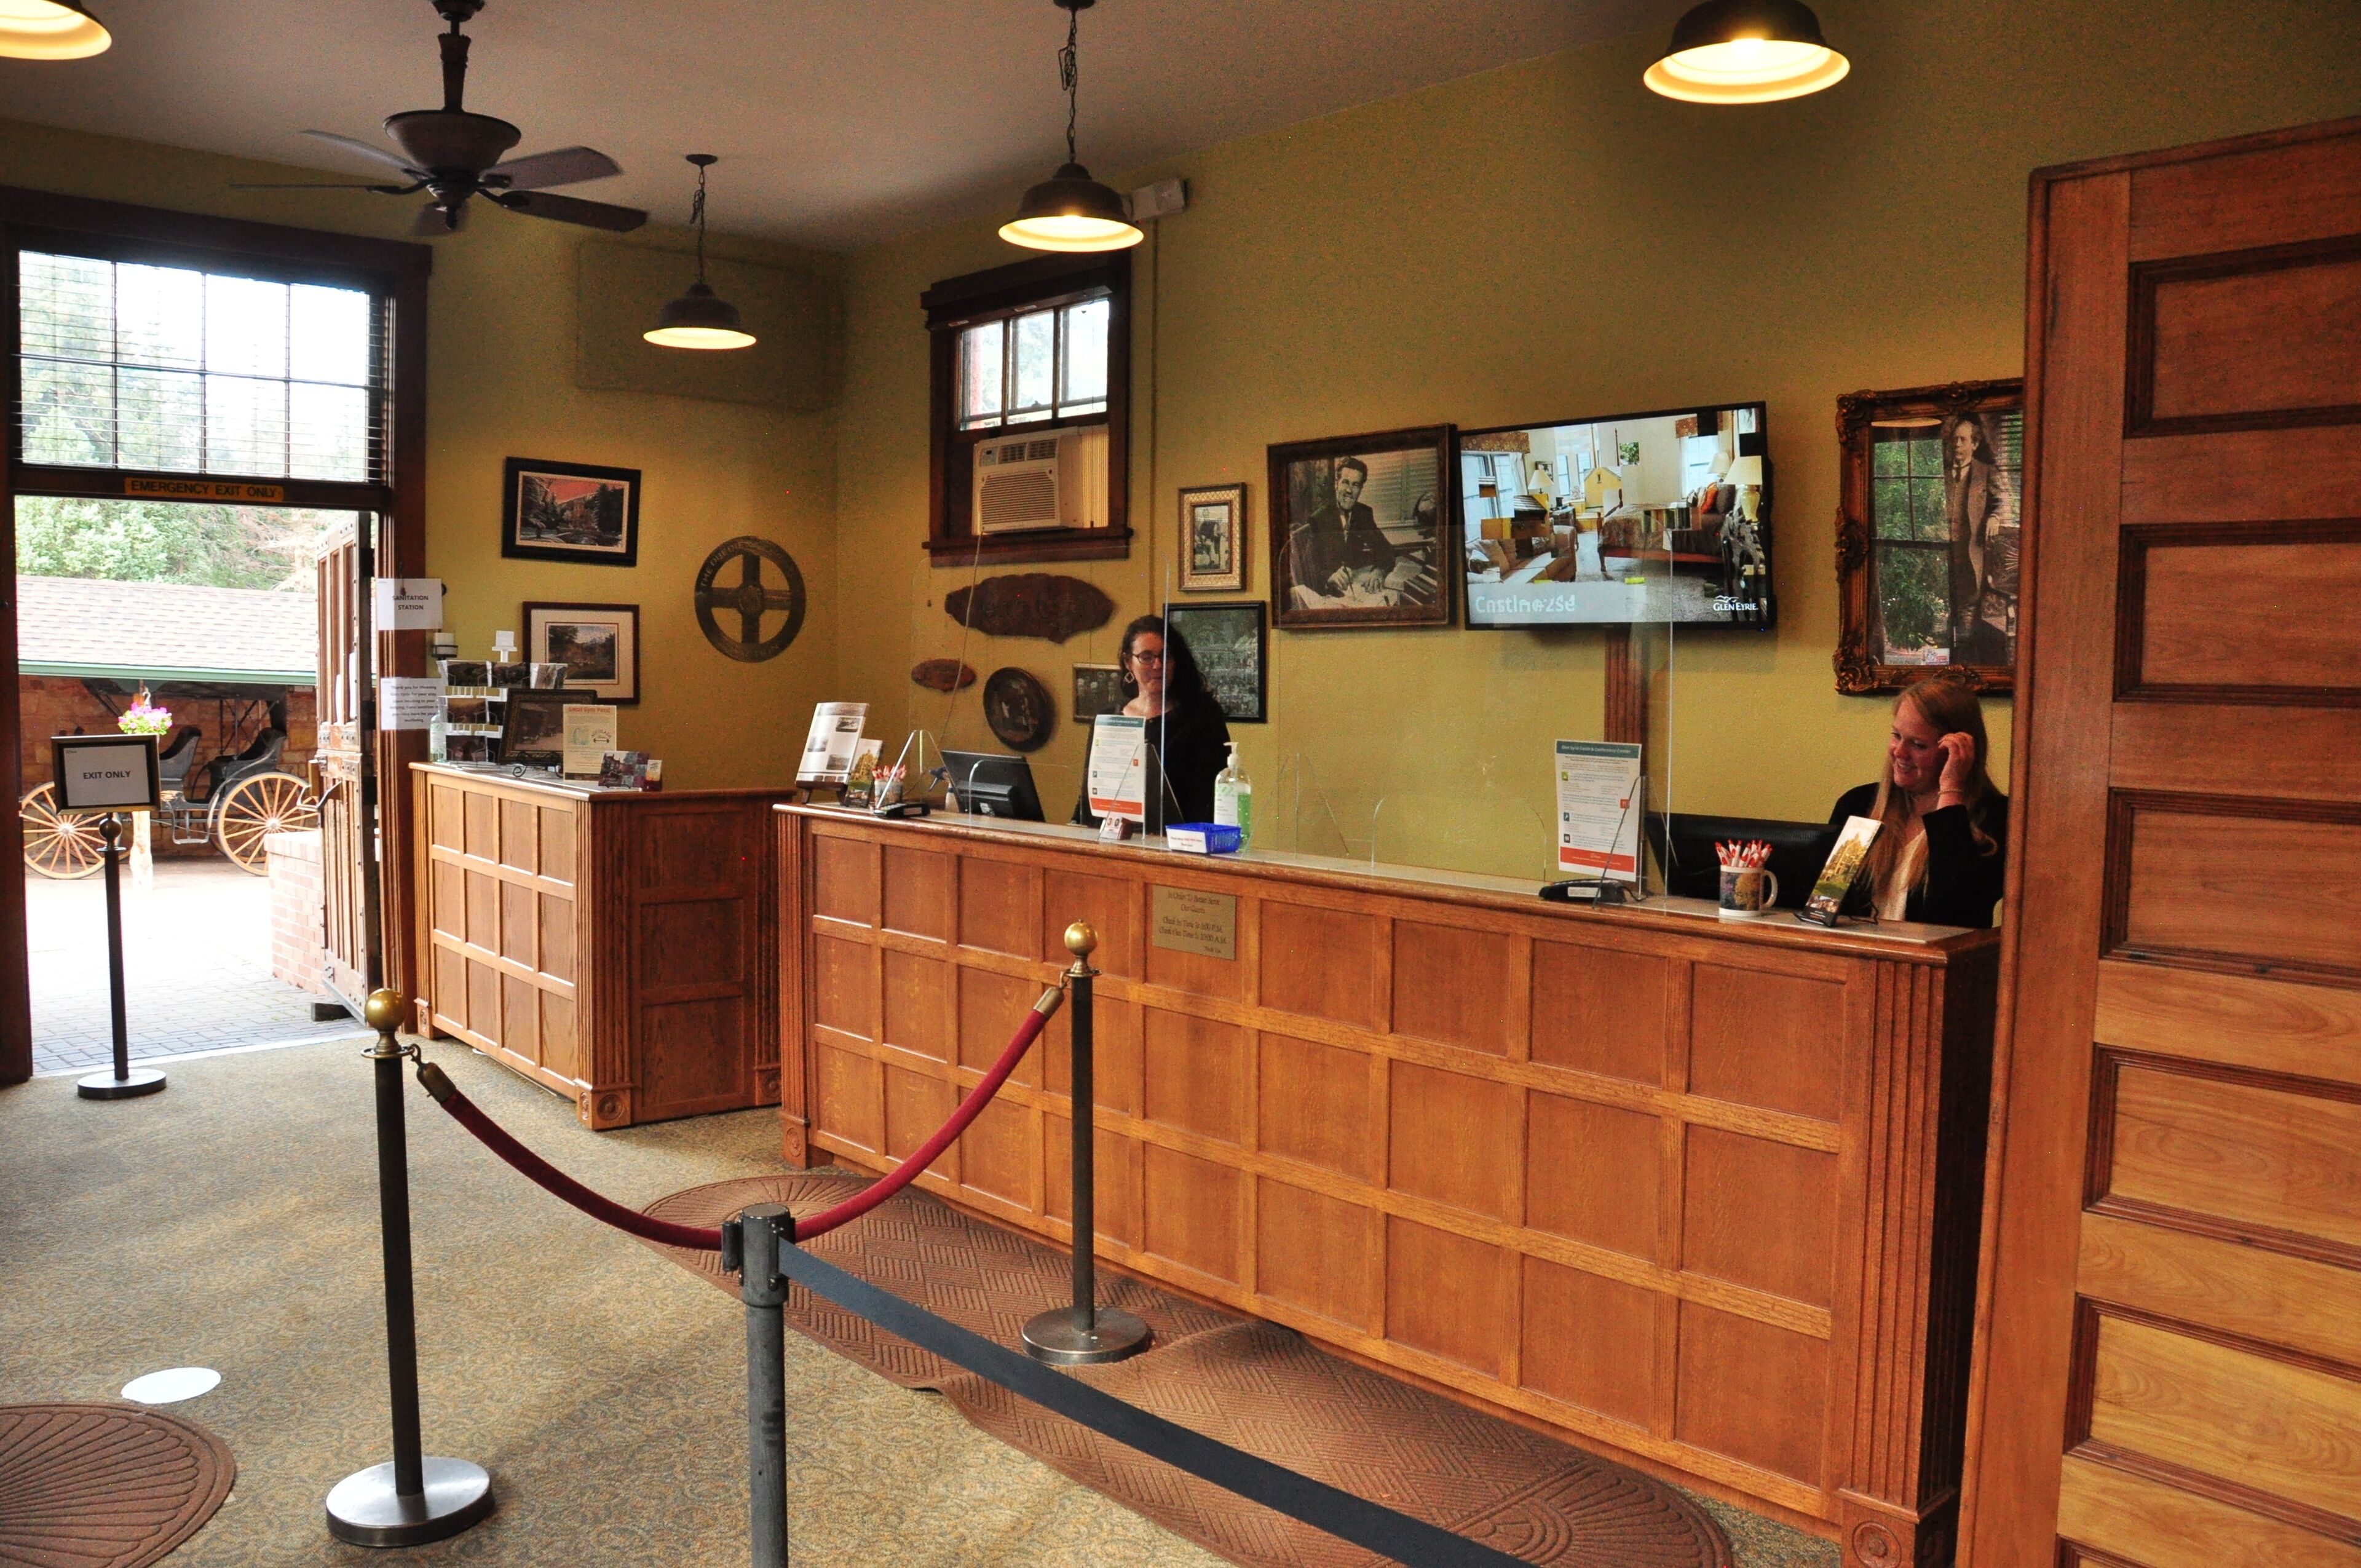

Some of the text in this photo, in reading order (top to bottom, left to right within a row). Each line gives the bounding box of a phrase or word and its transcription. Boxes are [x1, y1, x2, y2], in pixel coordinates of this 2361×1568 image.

[130, 480, 277, 497] EMERGENCY EXIT ONLY
